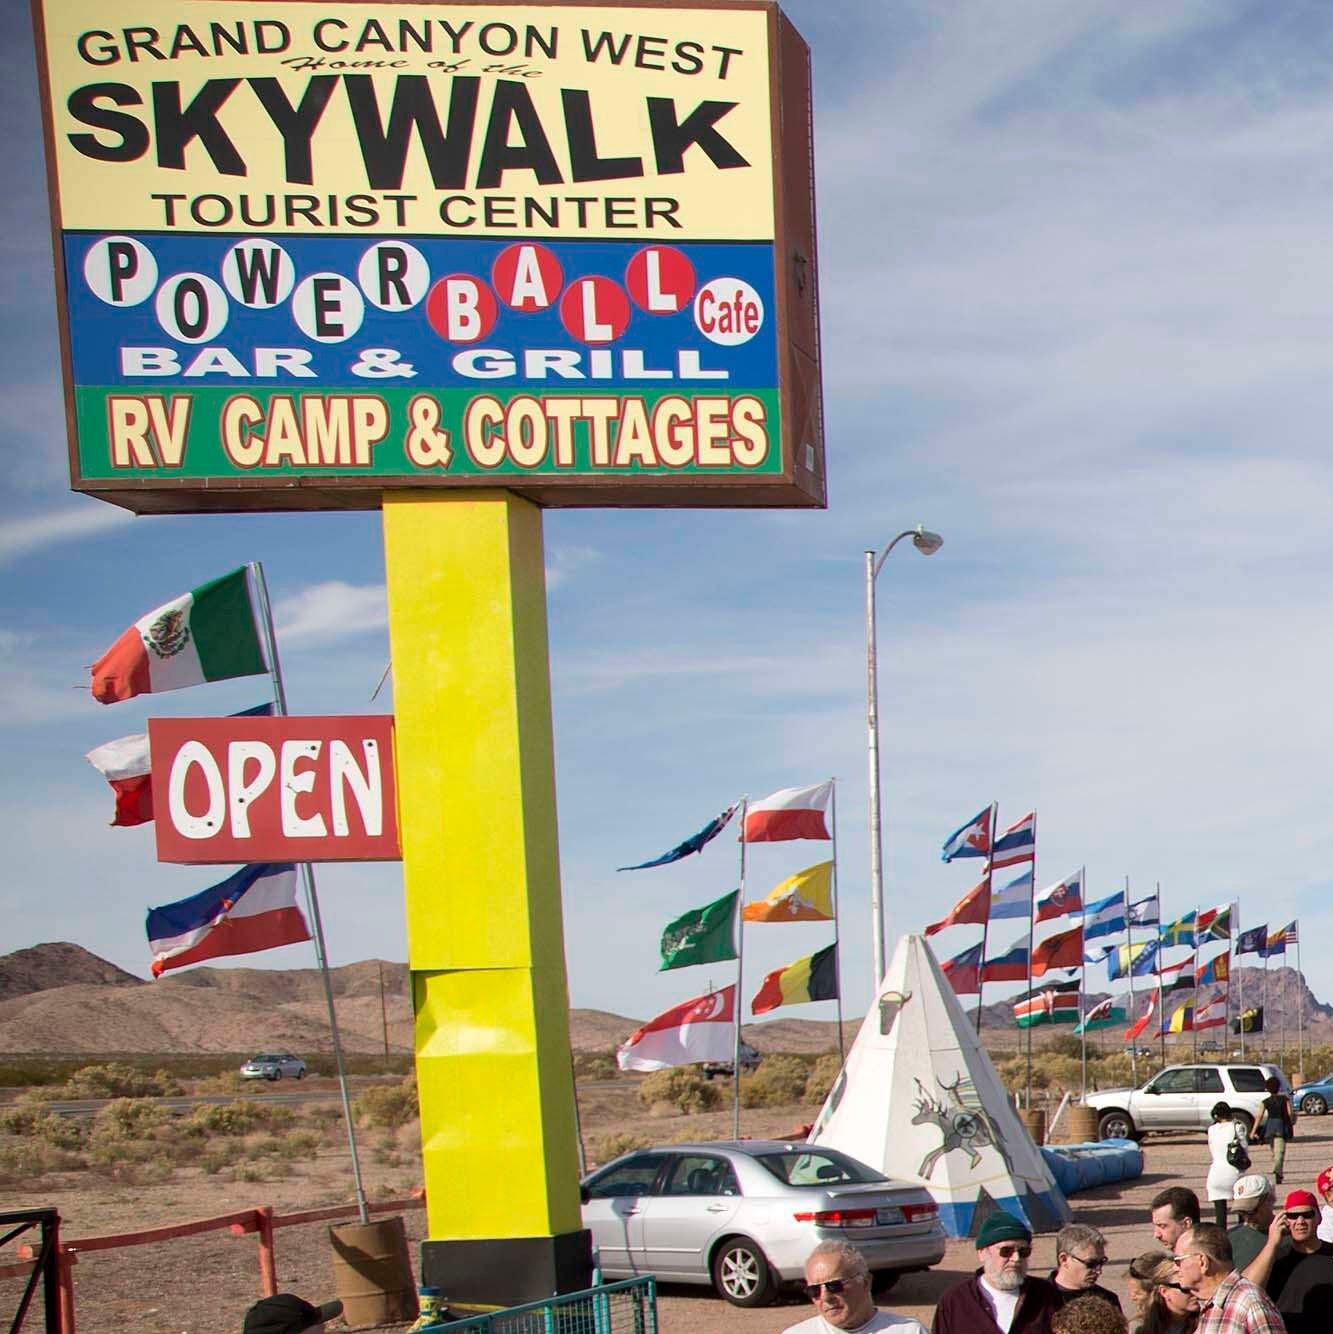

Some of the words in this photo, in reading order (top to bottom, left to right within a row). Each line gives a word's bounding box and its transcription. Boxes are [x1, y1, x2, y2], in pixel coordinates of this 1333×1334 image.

[77, 19, 291, 66] GRAND
[311, 17, 560, 60] CANYON
[581, 29, 744, 80] WEST
[280, 56, 410, 72] Home
[427, 58, 472, 73] of
[480, 63, 544, 79] the
[66, 72, 753, 191] SKYWALK
[151, 193, 418, 228] TOURIST
[439, 196, 684, 229] CENTER
[699, 293, 761, 337] Cafe
[121, 348, 317, 379] BAR
[351, 348, 415, 381] &
[453, 350, 730, 381] GRILL
[110, 396, 192, 470] RV
[223, 395, 389, 469] CAMP
[406, 395, 455, 471] &
[463, 396, 771, 471] COTTAGES
[168, 739, 383, 839] OPEN
